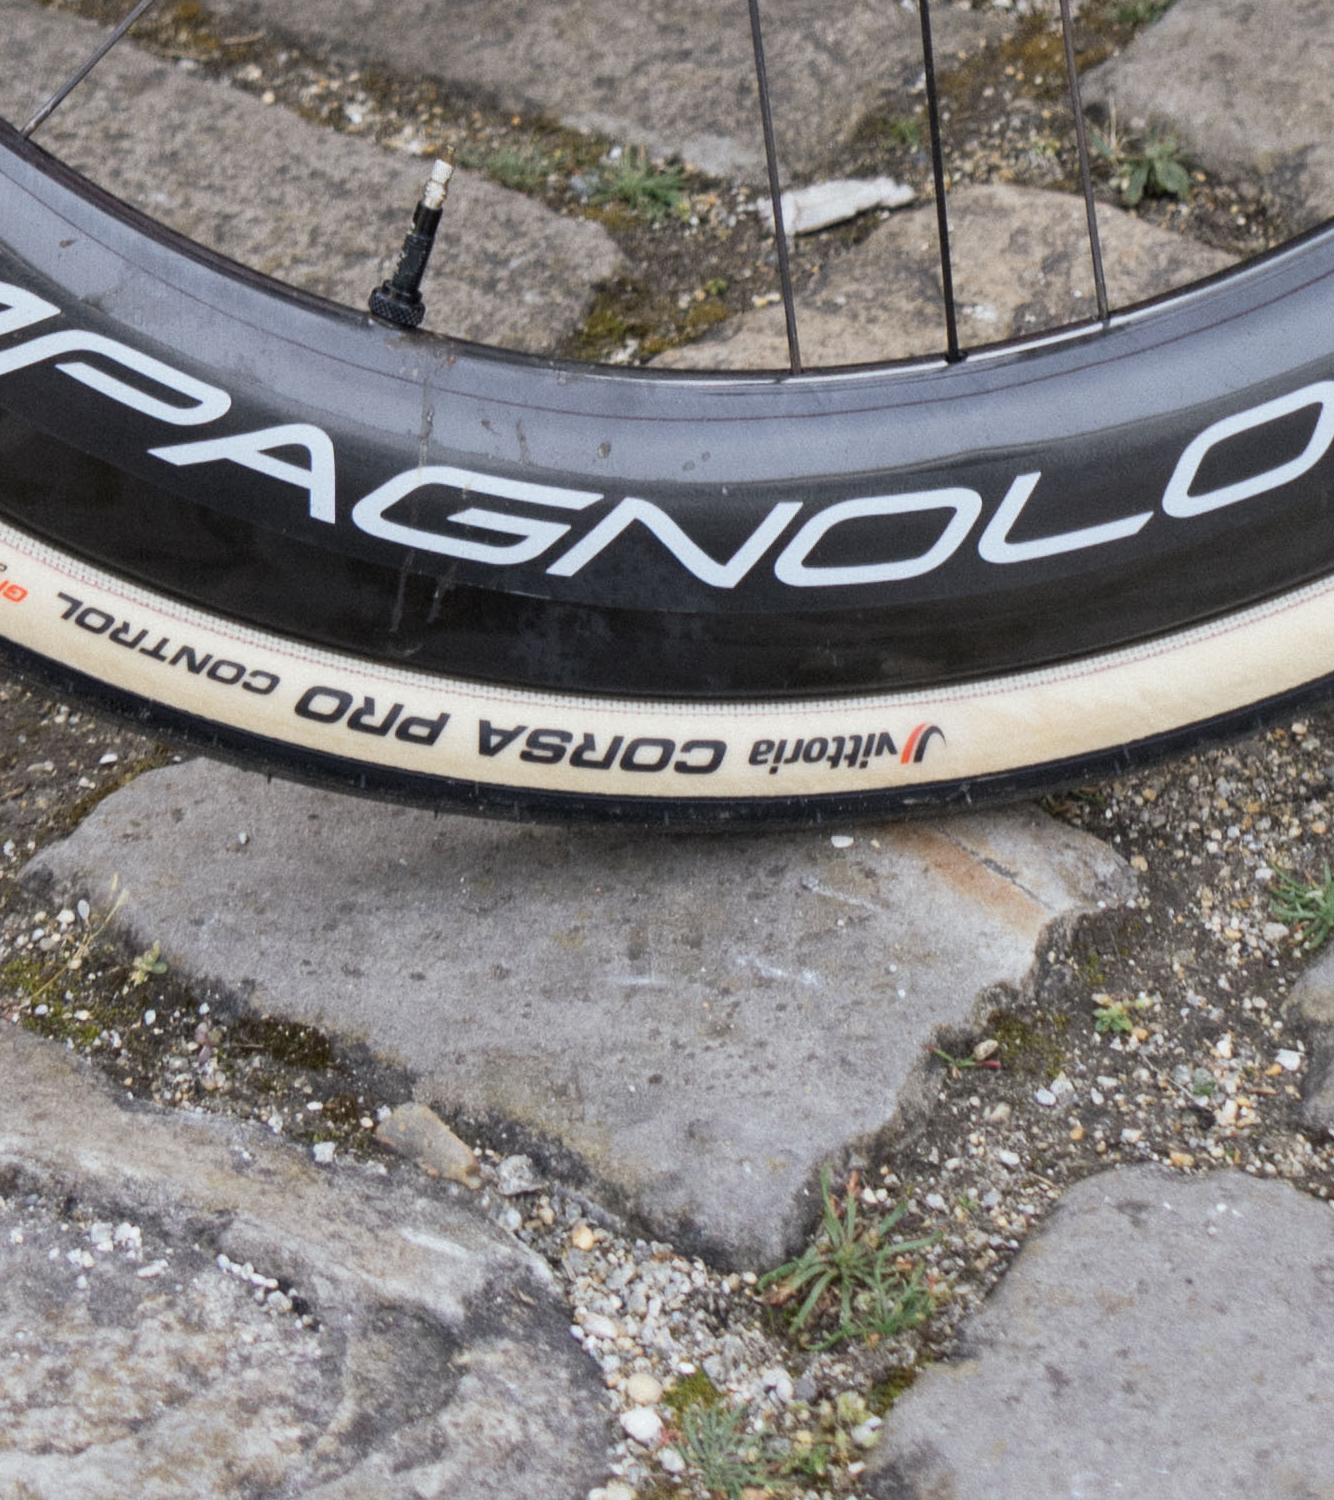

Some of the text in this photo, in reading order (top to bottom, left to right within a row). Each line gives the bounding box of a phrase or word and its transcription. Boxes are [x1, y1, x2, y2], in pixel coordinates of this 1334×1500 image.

[57, 590, 902, 778] vittoria CORSA PRO CONTROL
